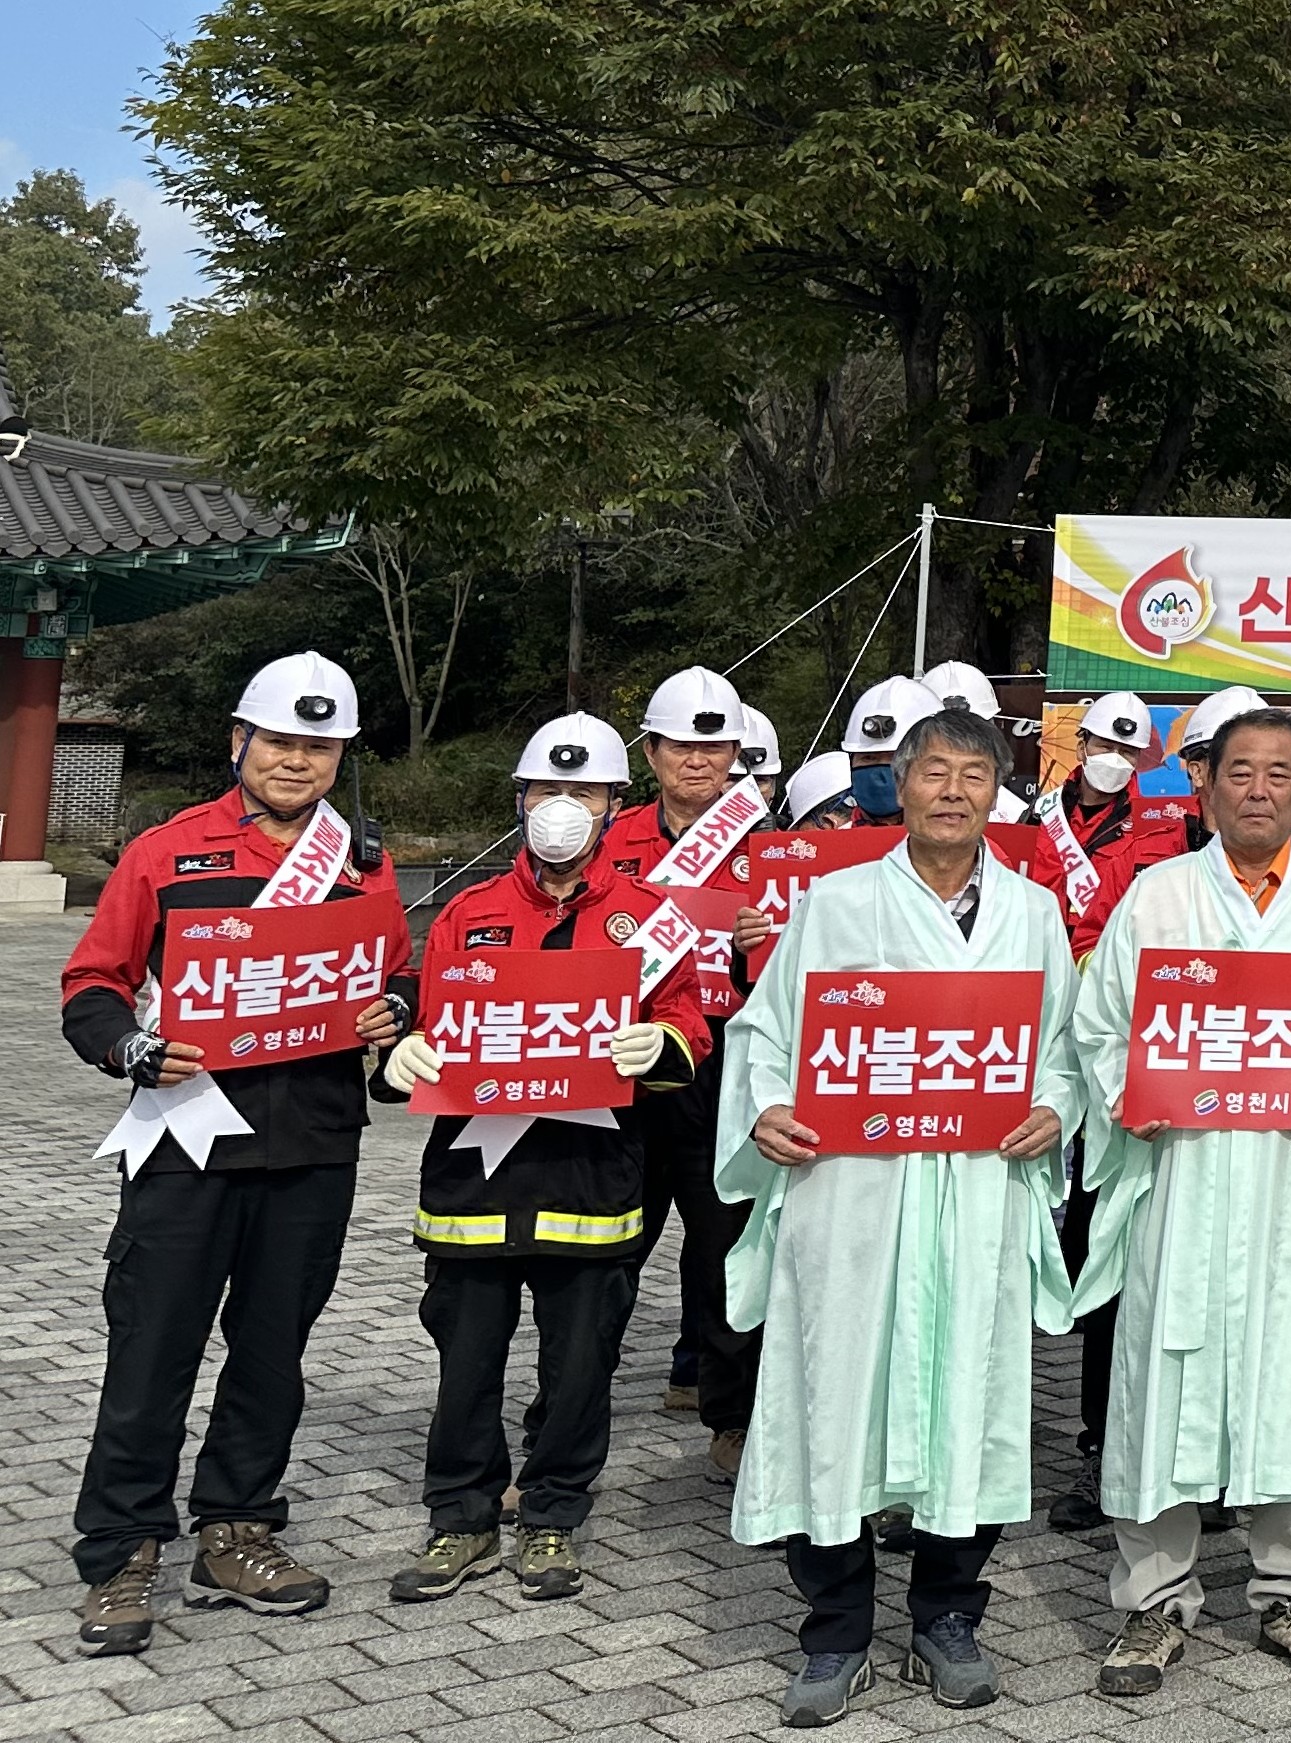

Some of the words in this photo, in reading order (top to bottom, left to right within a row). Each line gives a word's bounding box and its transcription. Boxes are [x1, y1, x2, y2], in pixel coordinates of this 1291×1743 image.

[671, 791, 761, 879] 불조심
[171, 934, 387, 1022] 산불조심
[263, 1023, 327, 1051] 영천시
[431, 995, 633, 1063] 산불조심
[808, 1024, 1032, 1096] 산불조심
[505, 1078, 570, 1101] 영천시
[1225, 1092, 1290, 1116] 영천시
[895, 1114, 964, 1139] 영천시
